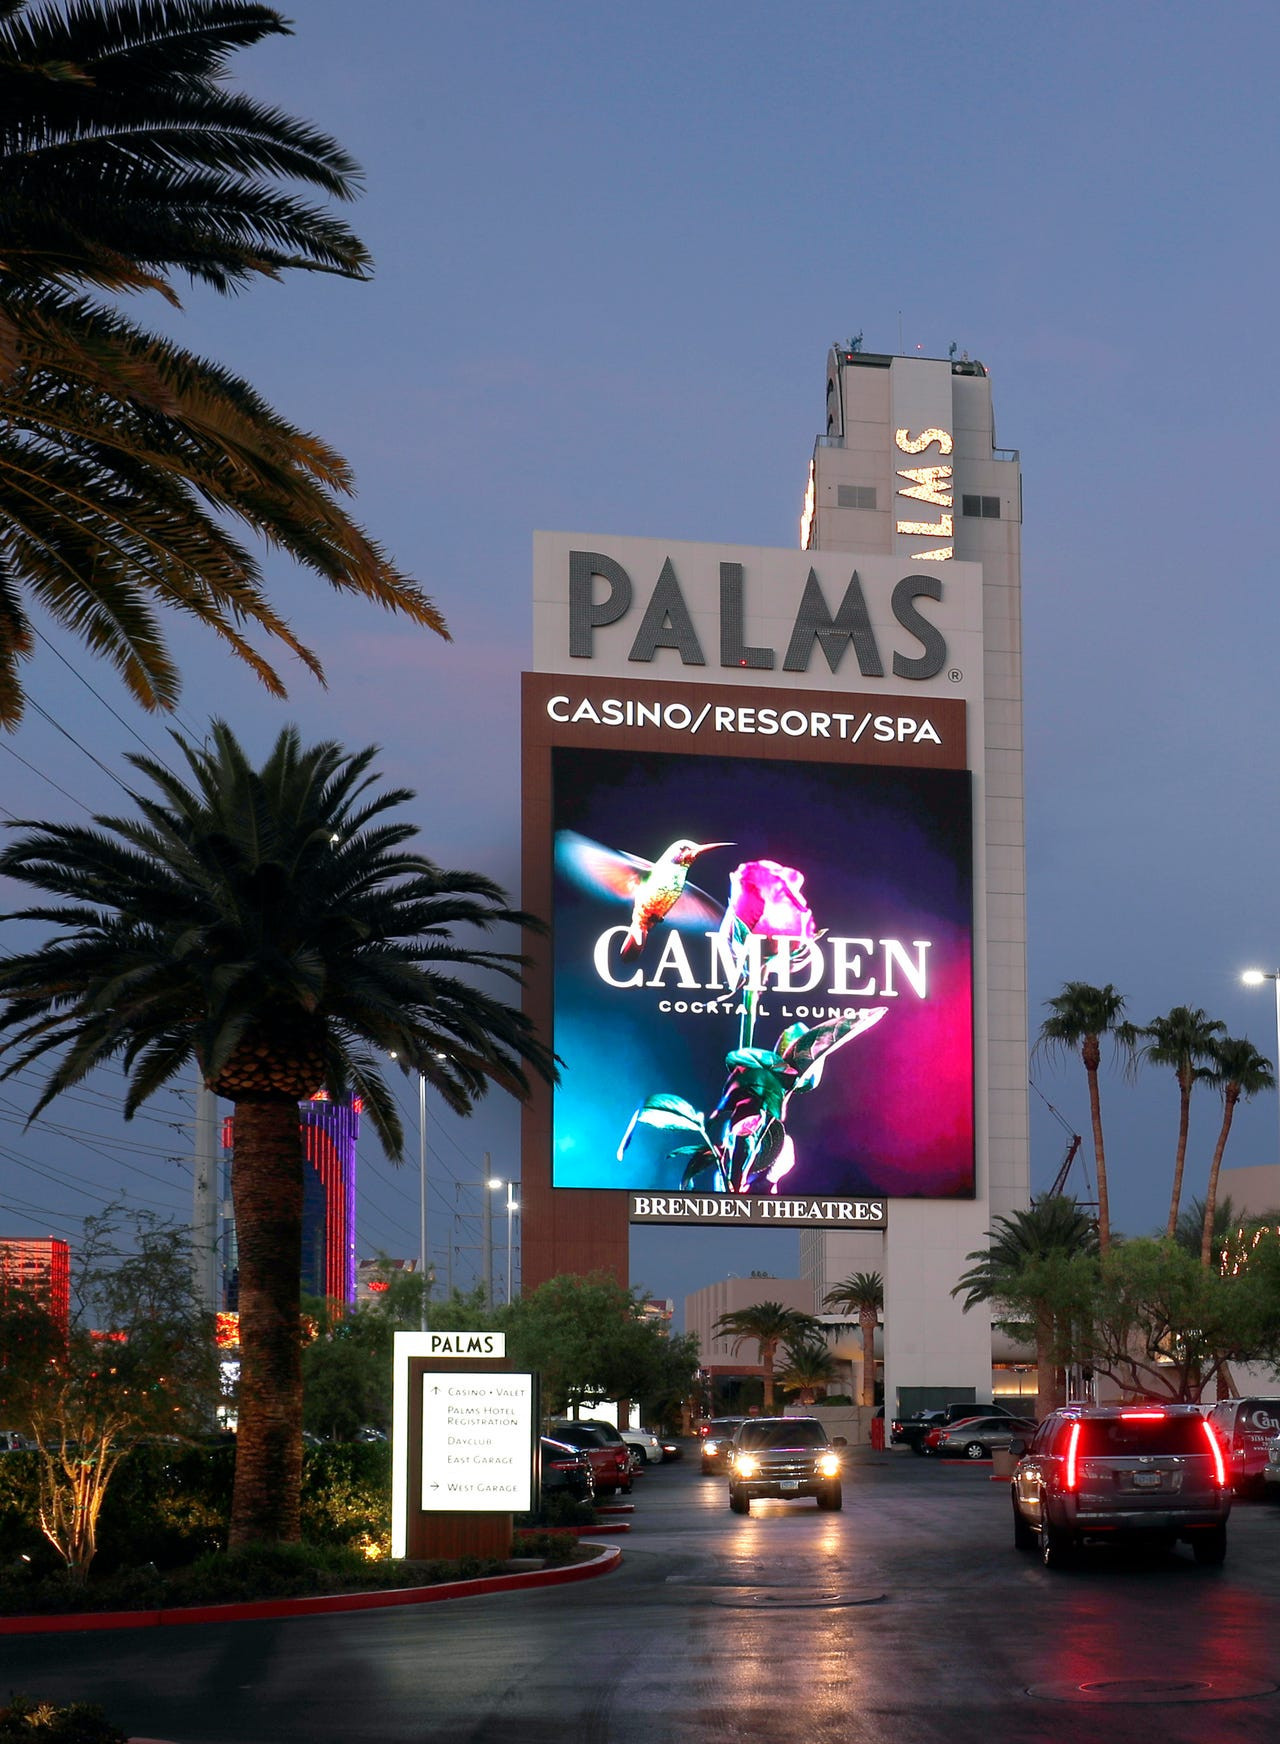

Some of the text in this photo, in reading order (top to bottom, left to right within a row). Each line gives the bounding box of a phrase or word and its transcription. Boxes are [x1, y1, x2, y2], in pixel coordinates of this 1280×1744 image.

[569, 550, 948, 682] PALMS
[546, 695, 943, 745] CASINO/RESORT/SPA
[593, 926, 932, 999] CAMDEN
[658, 1000, 769, 1016] COCKTAL
[634, 1197, 883, 1222] BRENDEN THEATRES
[431, 1335, 494, 1353] PALMS
[1252, 1410, 1280, 1430] Can
